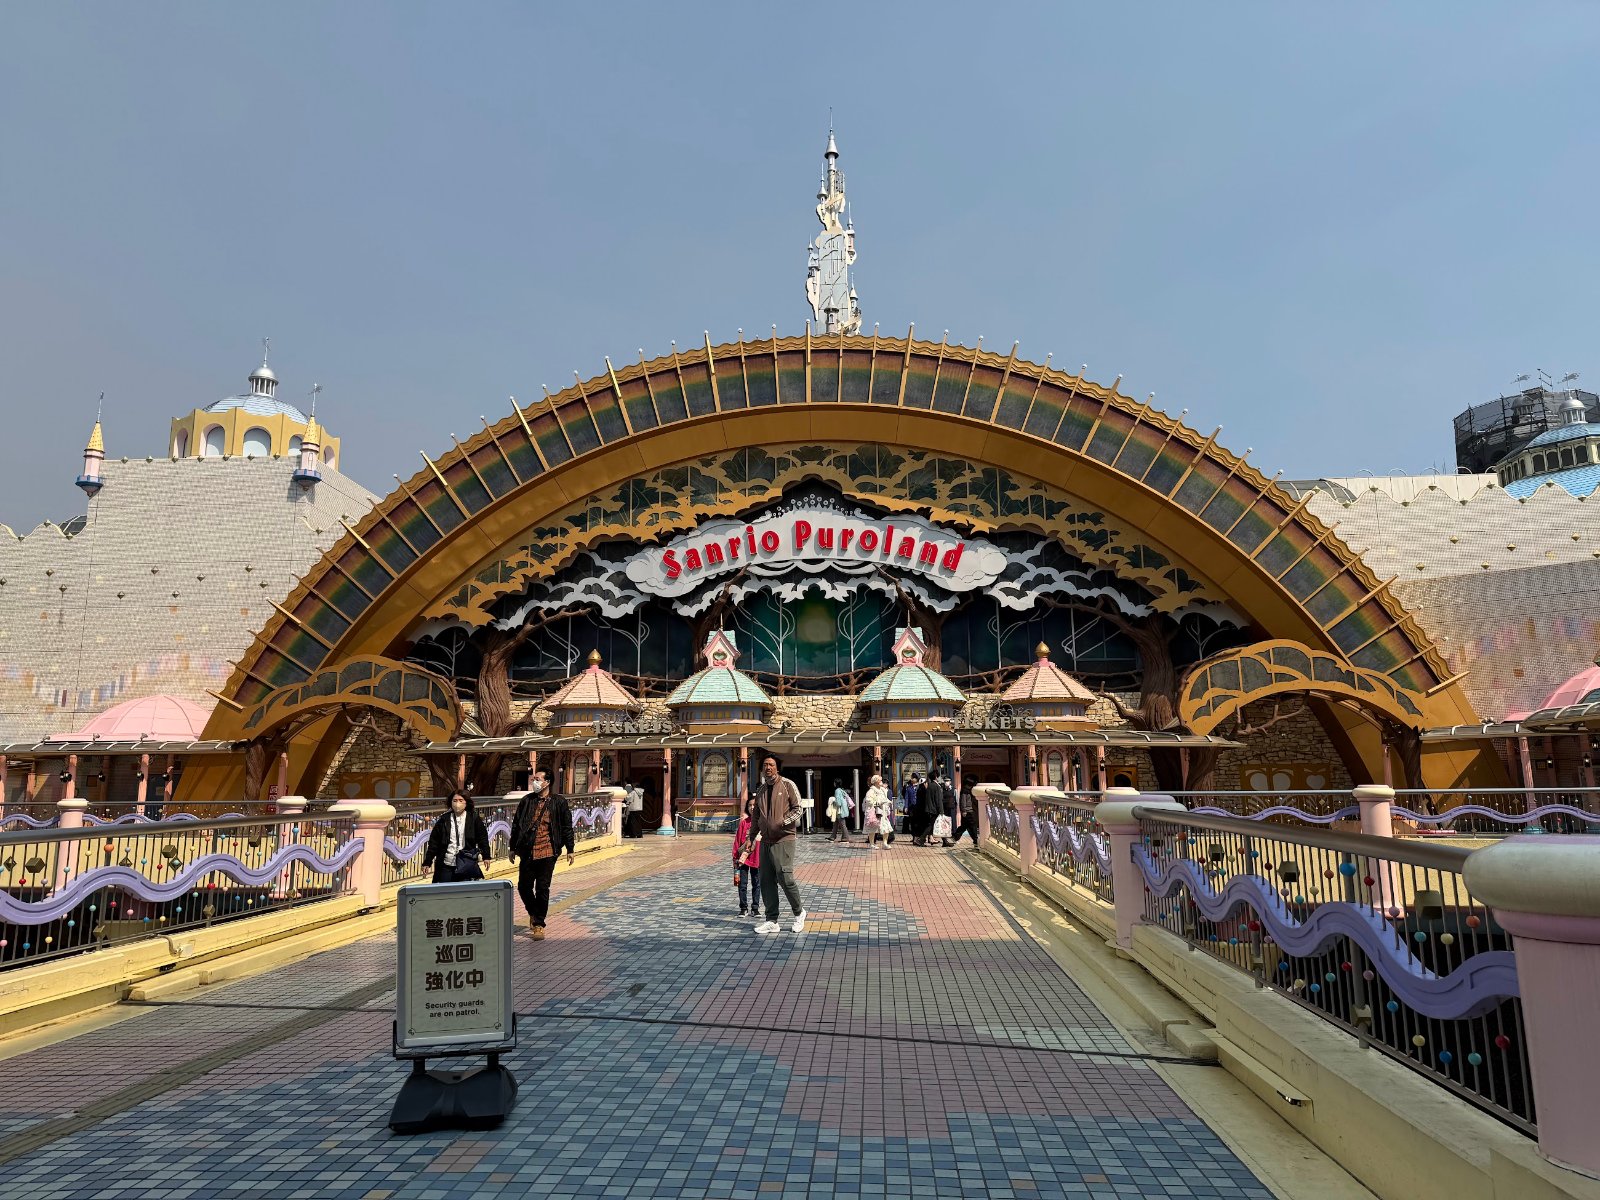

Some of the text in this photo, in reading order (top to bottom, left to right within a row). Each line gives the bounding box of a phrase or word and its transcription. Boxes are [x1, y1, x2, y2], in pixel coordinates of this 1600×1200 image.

[662, 519, 966, 579] Sanrio Puroland
[592, 720, 673, 734] TICKETS
[953, 716, 1036, 730] TICKETS
[425, 916, 484, 938] 警備員
[435, 943, 474, 964] 巡回
[425, 968, 484, 991] 強化中
[425, 999, 484, 1009] Security guards
[455, 1008, 480, 1017] patrol.
